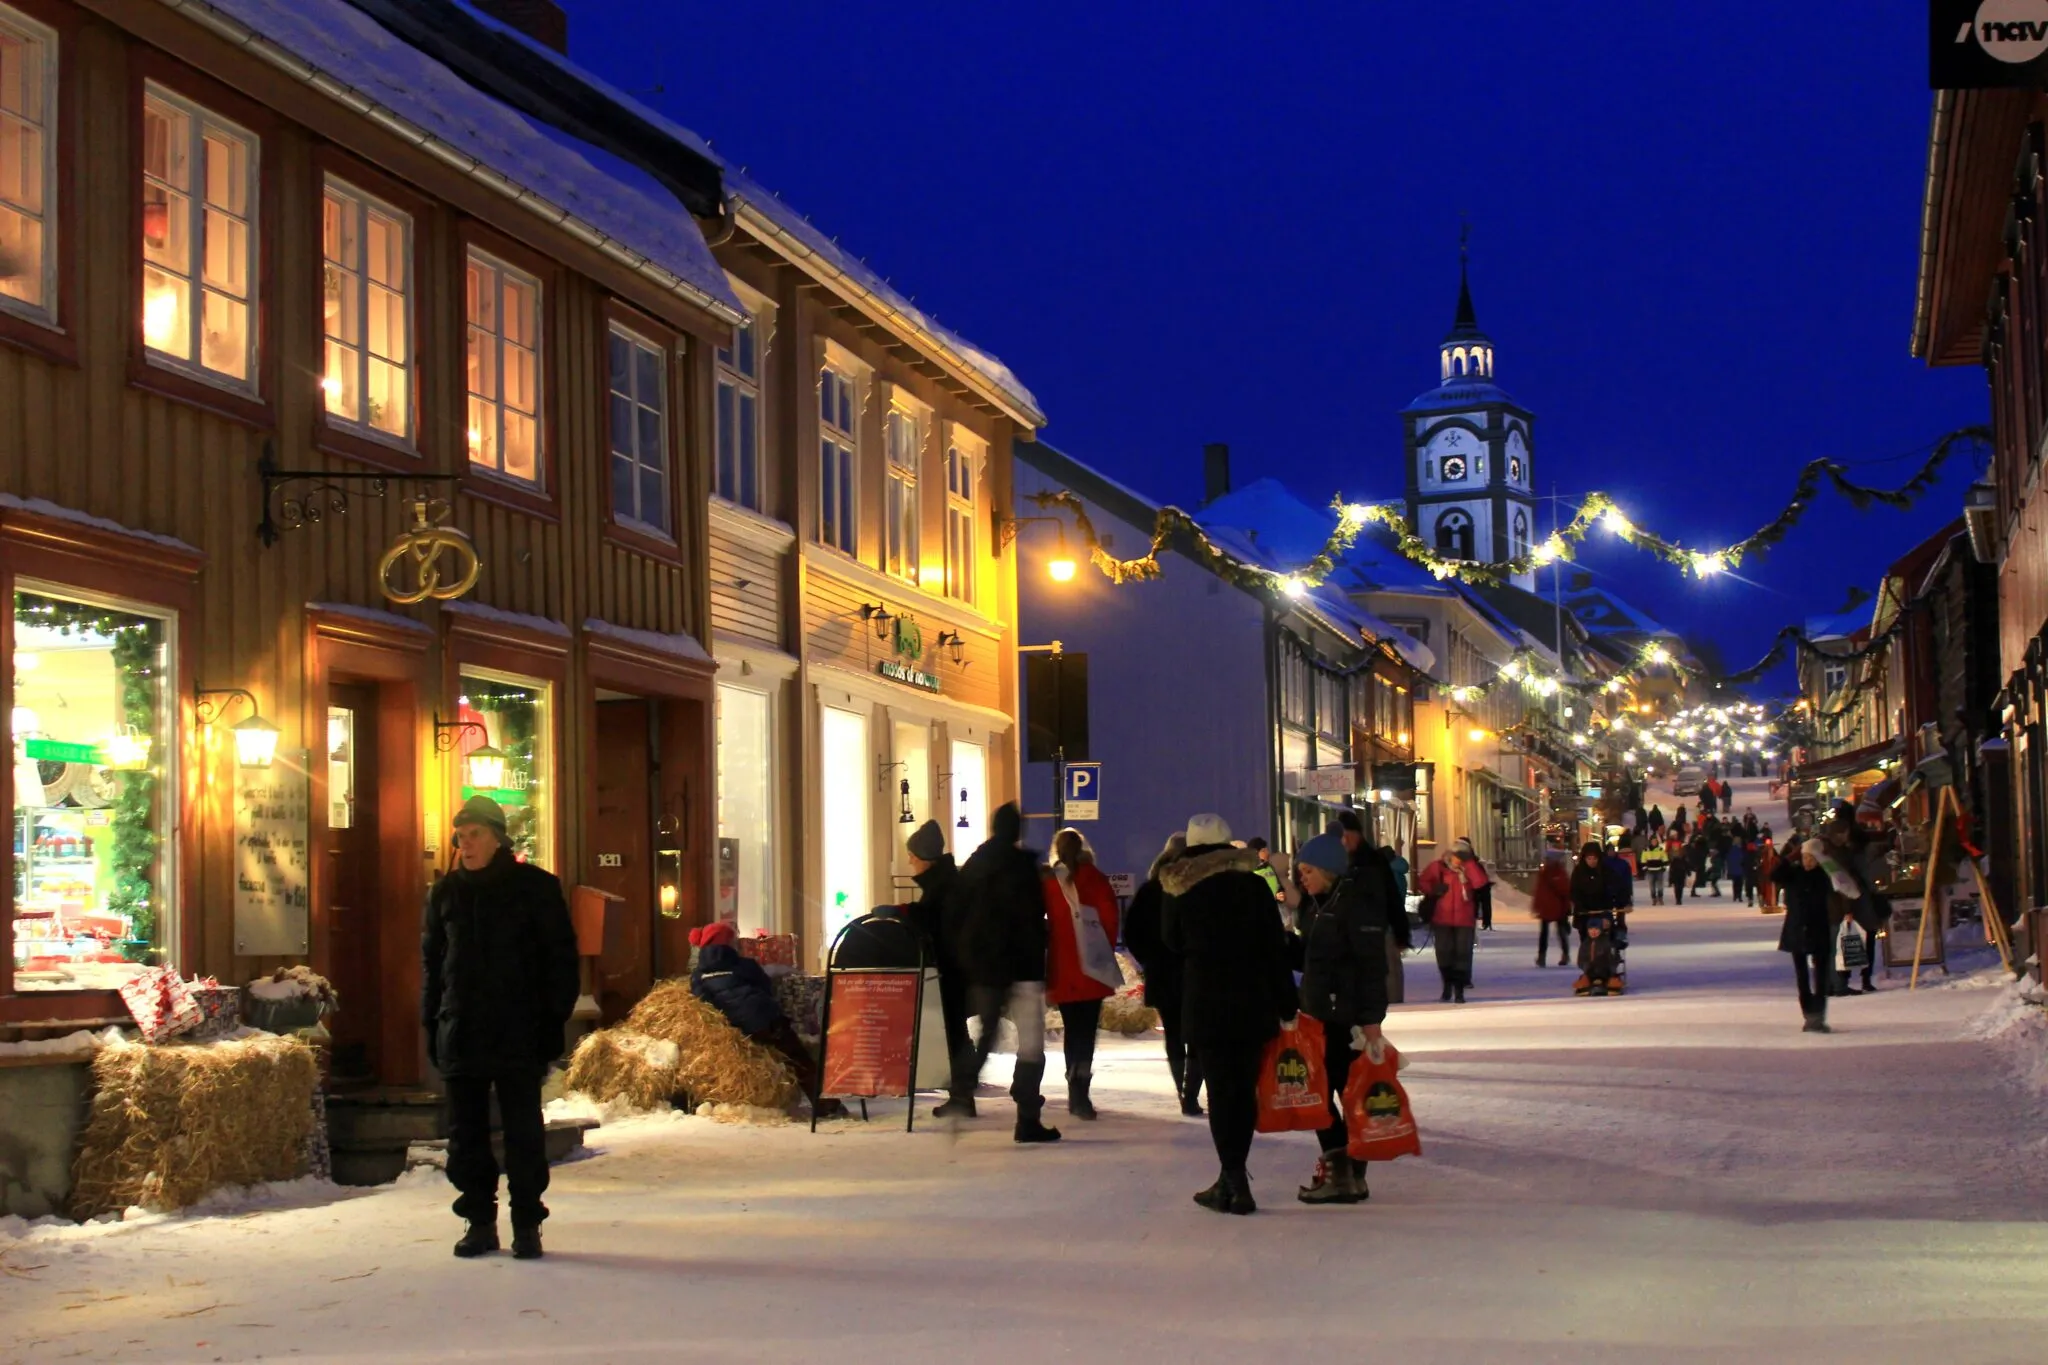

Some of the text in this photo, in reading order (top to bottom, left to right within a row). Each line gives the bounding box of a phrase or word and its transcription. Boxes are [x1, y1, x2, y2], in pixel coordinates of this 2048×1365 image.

[882, 663, 939, 690] moods of norway
[1073, 770, 1091, 797] P
[1277, 1058, 1307, 1077] nille
